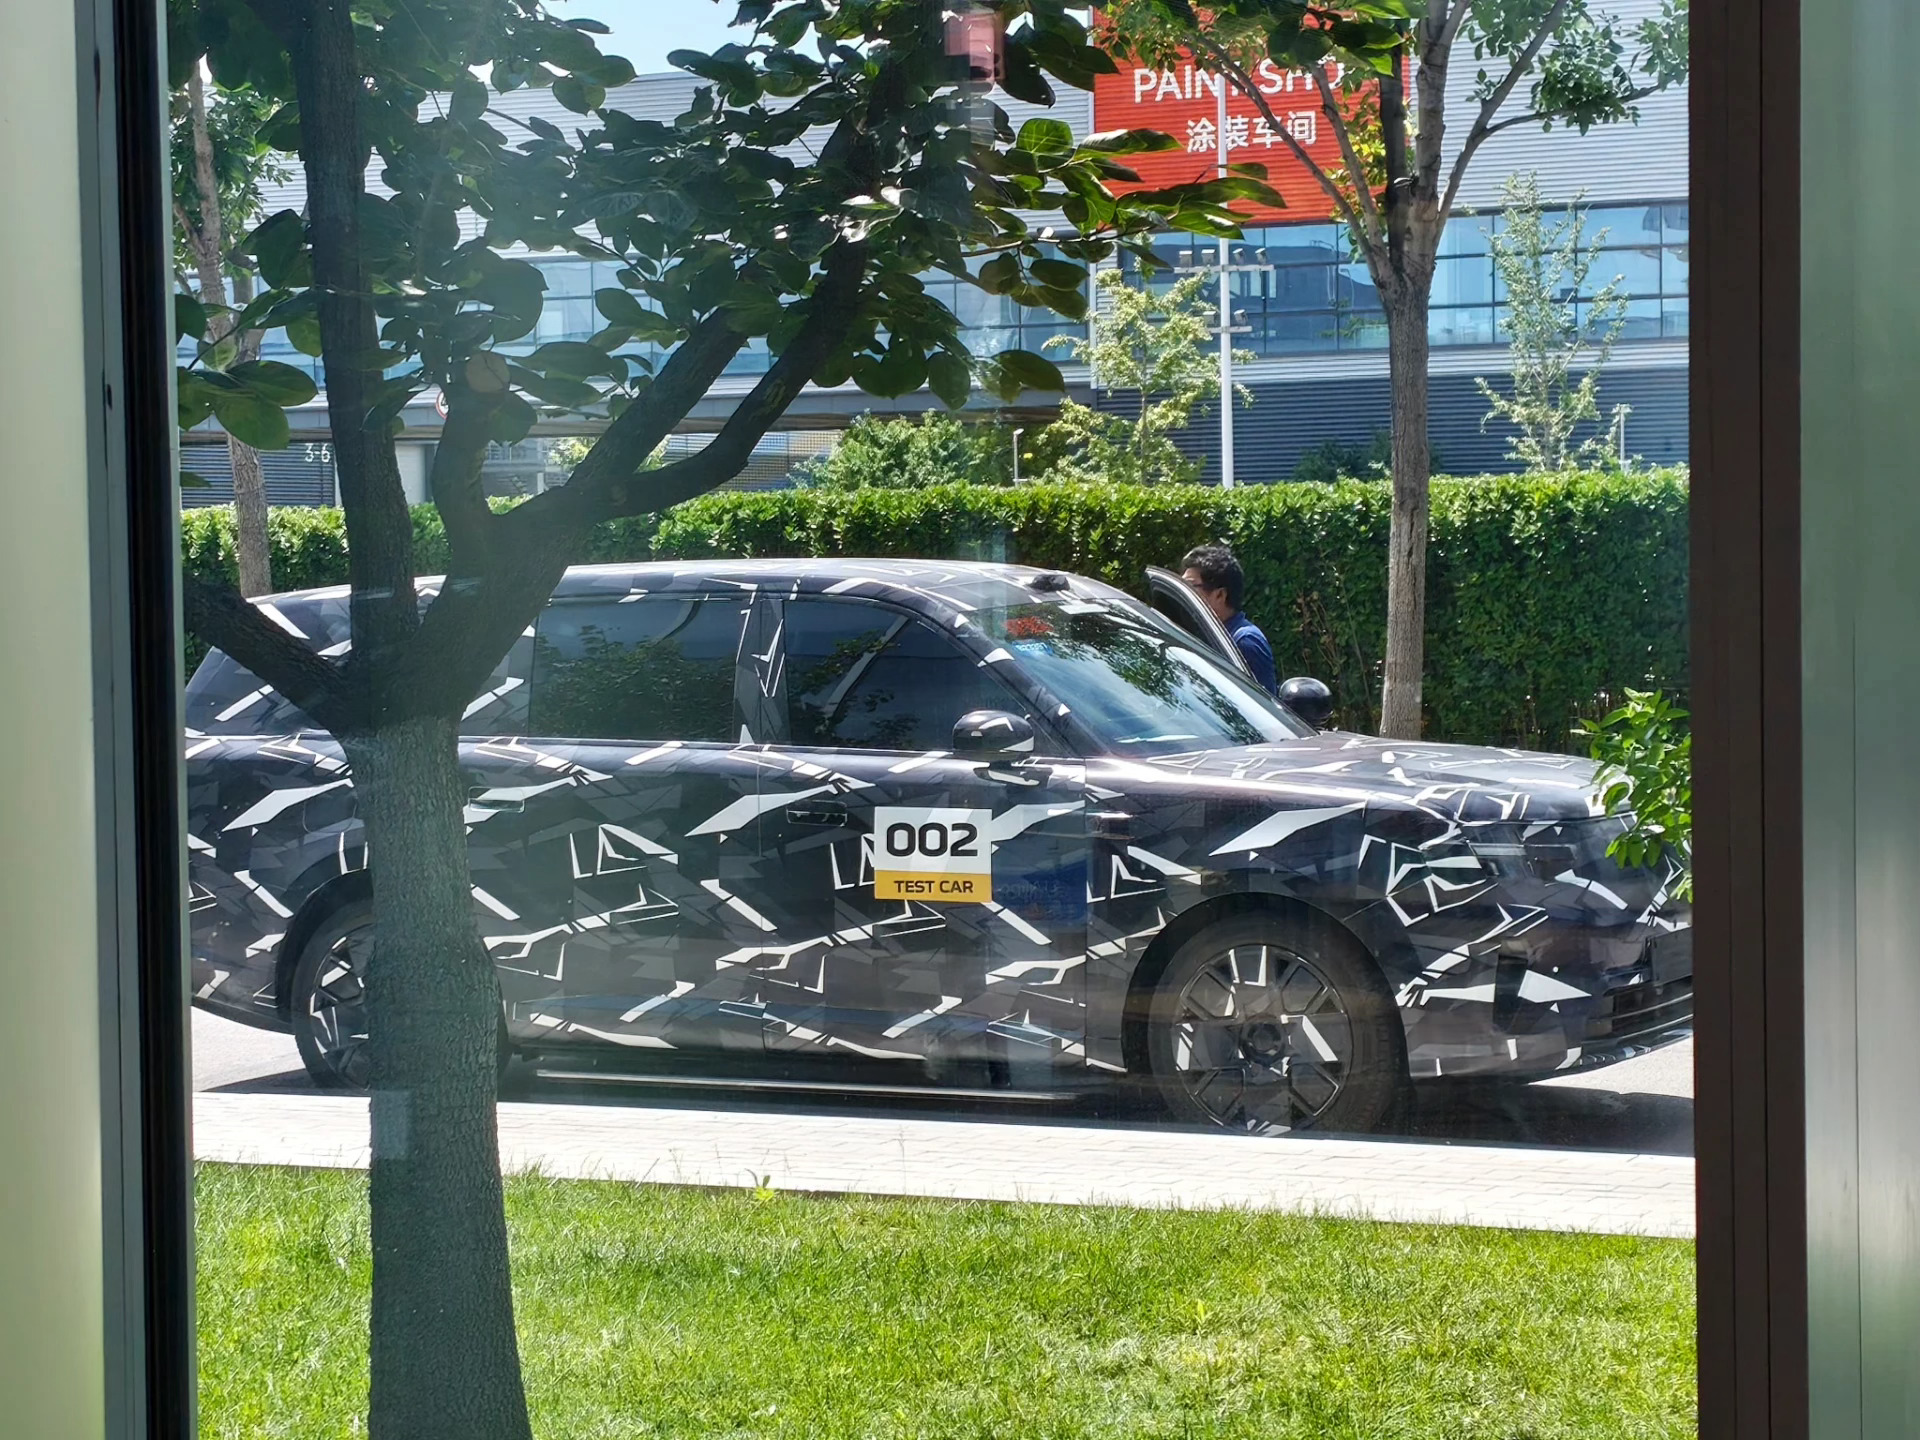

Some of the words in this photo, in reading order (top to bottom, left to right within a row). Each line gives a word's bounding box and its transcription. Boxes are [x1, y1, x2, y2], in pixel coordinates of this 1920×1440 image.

[1185, 111, 1316, 154] 涂装车间
[304, 442, 331, 463] 3-6
[886, 822, 978, 857] 002
[893, 880, 935, 894] TEST
[939, 880, 974, 894] CAR
